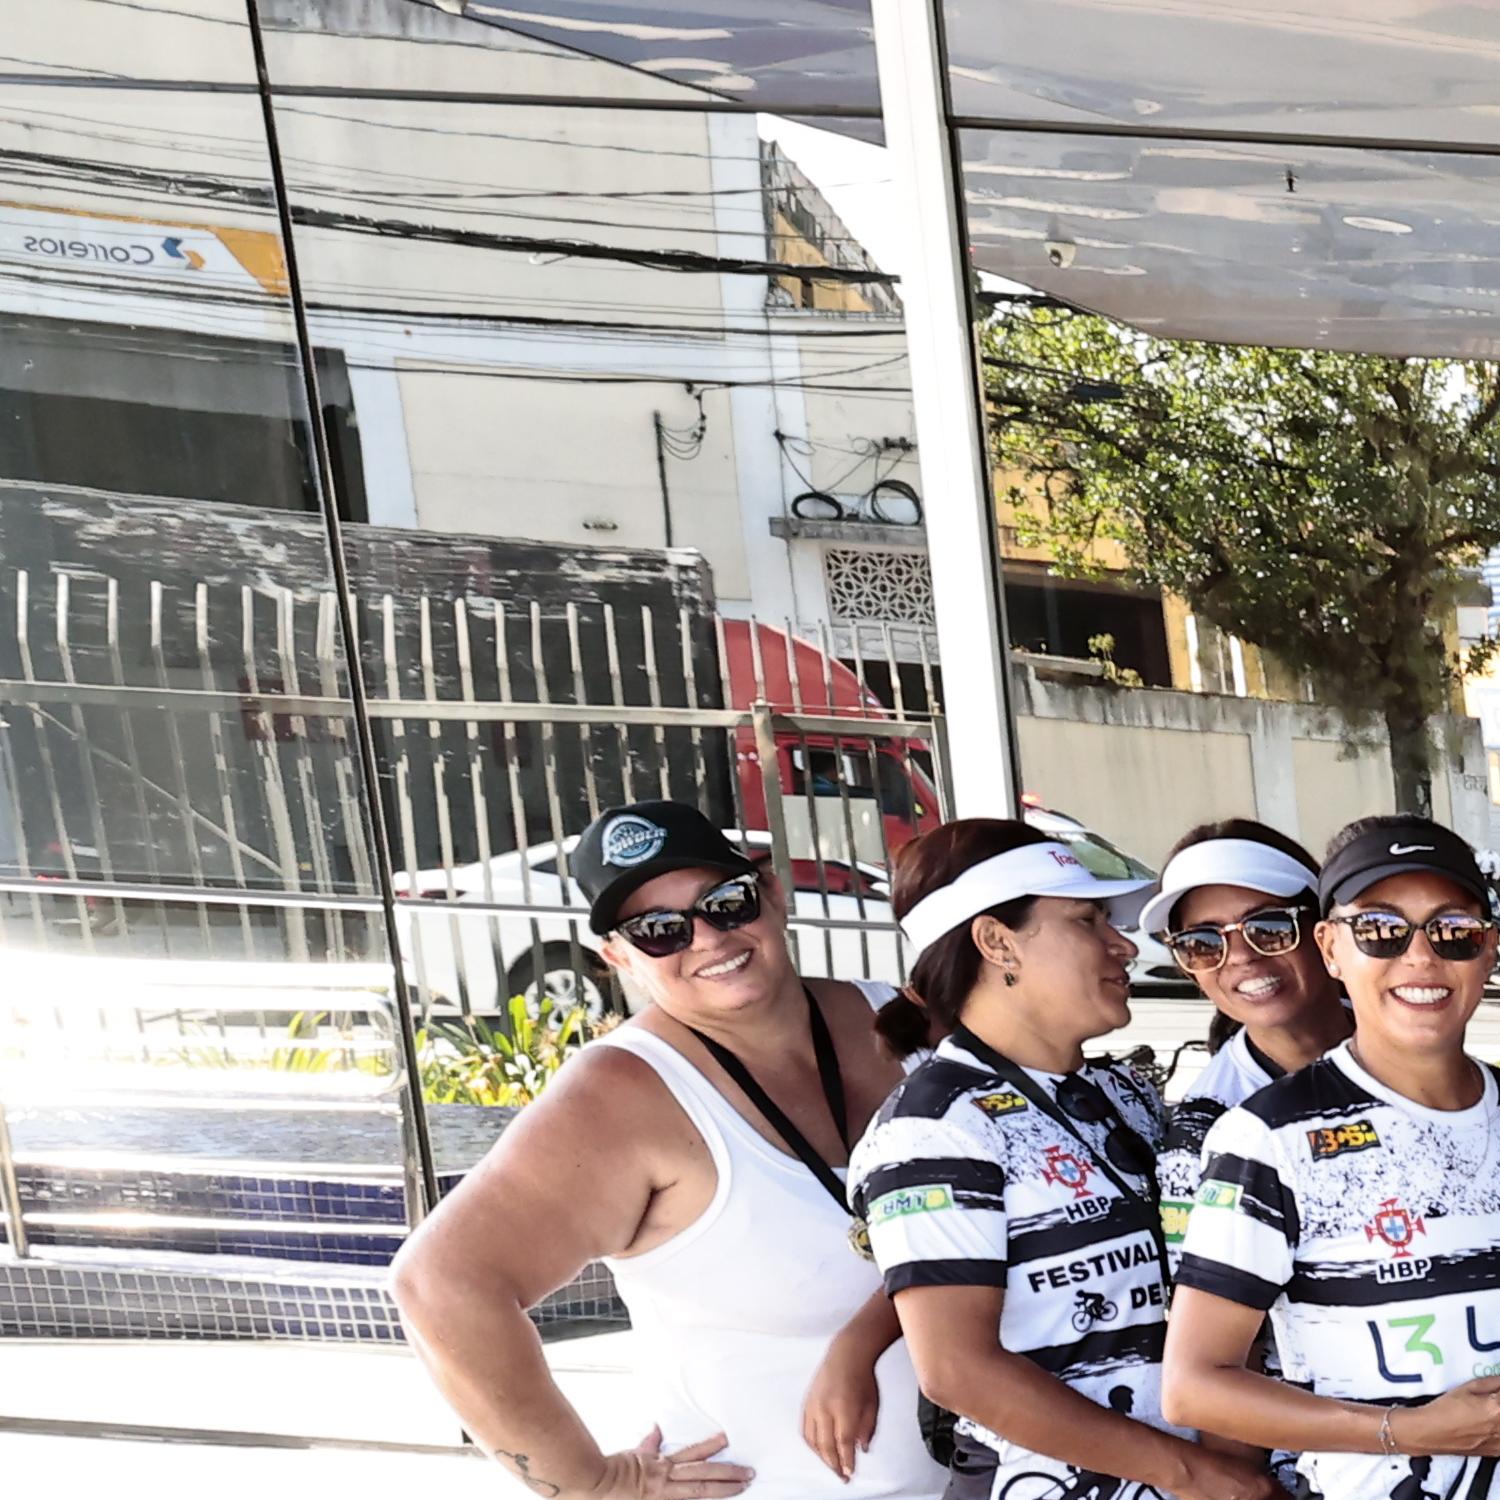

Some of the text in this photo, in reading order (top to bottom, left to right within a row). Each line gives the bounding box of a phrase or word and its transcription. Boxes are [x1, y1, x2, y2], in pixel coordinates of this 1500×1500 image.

[1066, 1198, 1111, 1223] HBP
[1028, 1241, 1160, 1293] FESTIVAL
[1378, 1259, 1431, 1284] HBP
